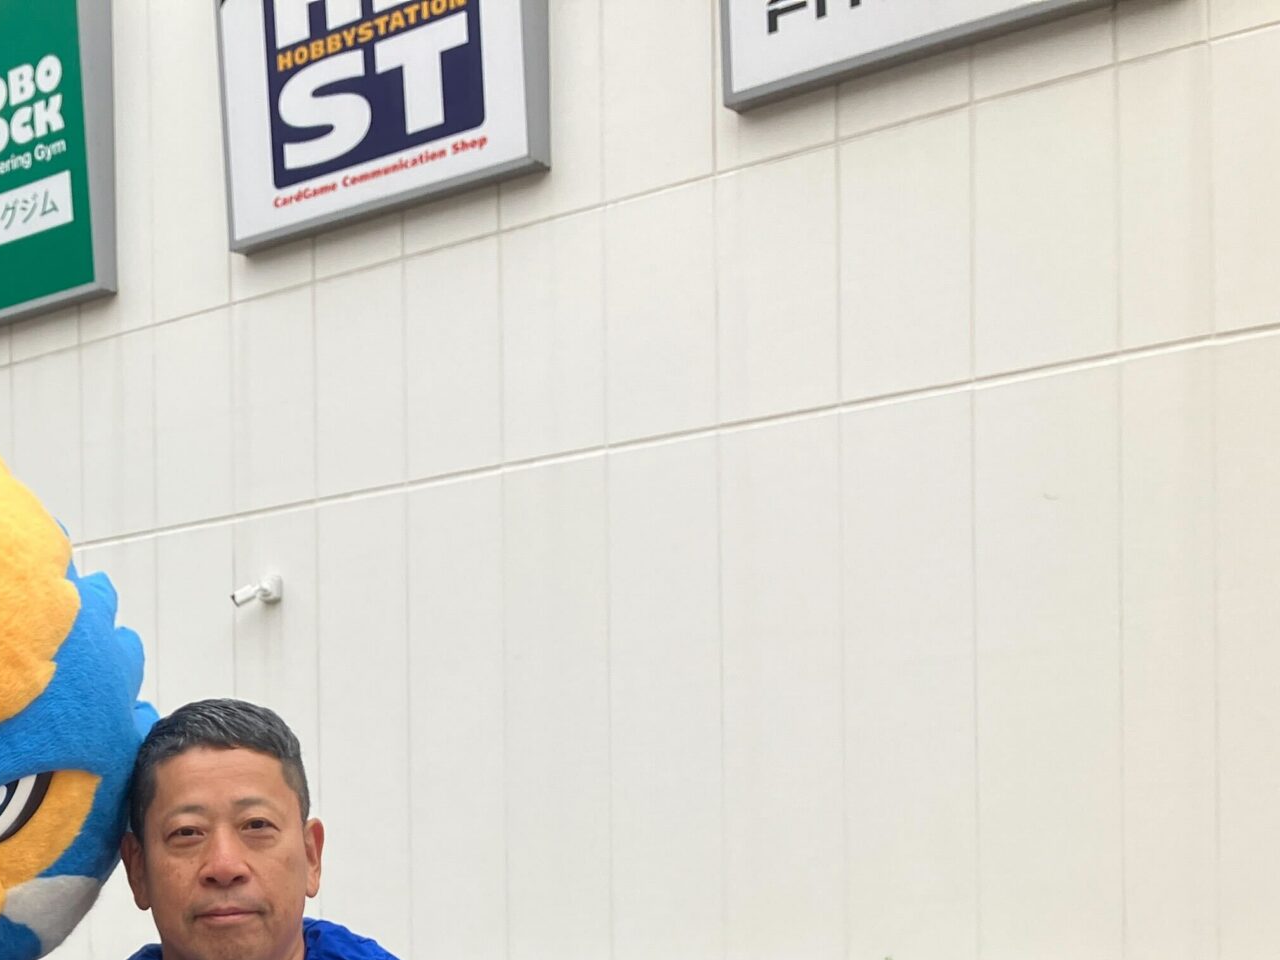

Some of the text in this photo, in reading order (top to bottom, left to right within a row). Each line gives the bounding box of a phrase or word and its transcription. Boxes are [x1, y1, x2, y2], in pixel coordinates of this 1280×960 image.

[277, 0, 467, 72] HOBBYSTATION
[278, 10, 469, 171] ST
[34, 139, 67, 162] Gym
[342, 148, 448, 188] Communication
[451, 135, 488, 157] Shop
